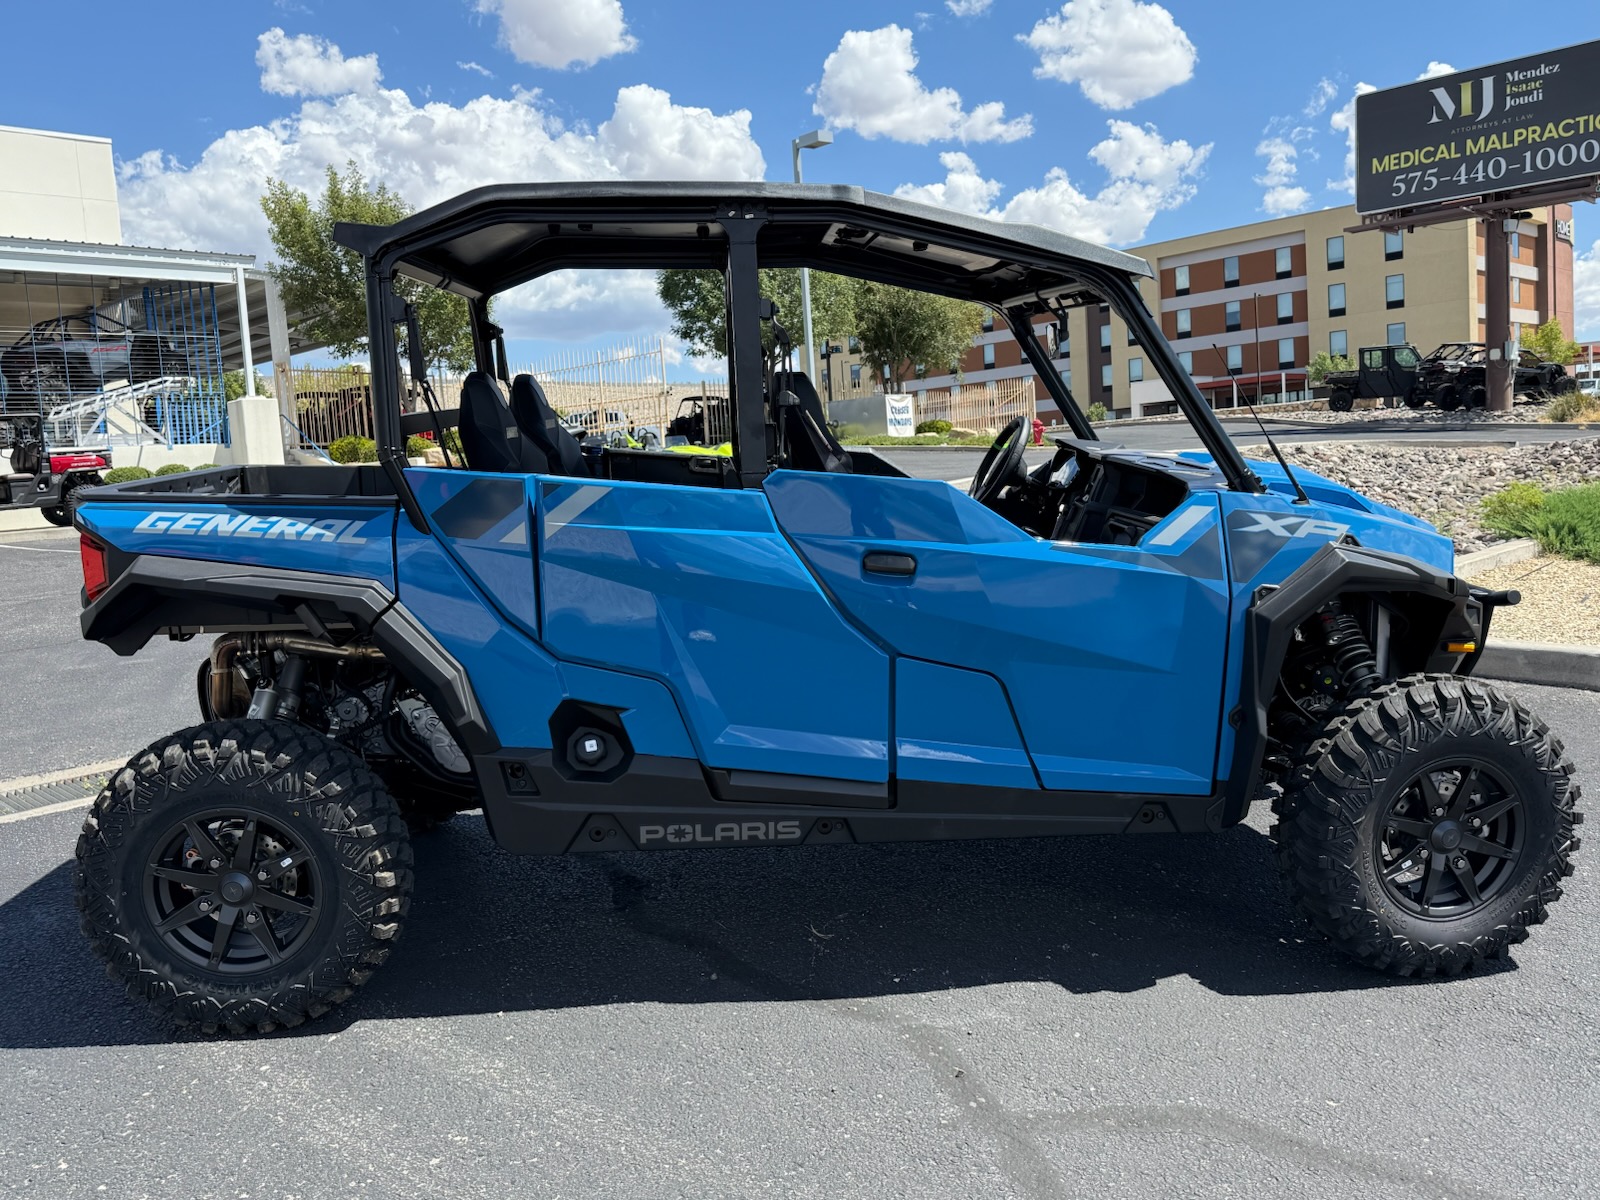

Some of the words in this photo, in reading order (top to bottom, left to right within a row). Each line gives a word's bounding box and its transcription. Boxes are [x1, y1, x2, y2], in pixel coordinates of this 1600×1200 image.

[1505, 63, 1561, 84] Mendez
[1505, 79, 1544, 95] Isaac
[1503, 89, 1544, 112] Joudi
[1450, 120, 1499, 135] ATTORNEYS
[1501, 117, 1512, 125] AT
[1515, 113, 1534, 122] LAW
[1371, 141, 1462, 175] MEDICAL
[1391, 138, 1600, 197] 575-440-1000
[132, 511, 368, 545] GENERAL
[1232, 512, 1351, 539] XP
[639, 820, 802, 844] POLARIS
